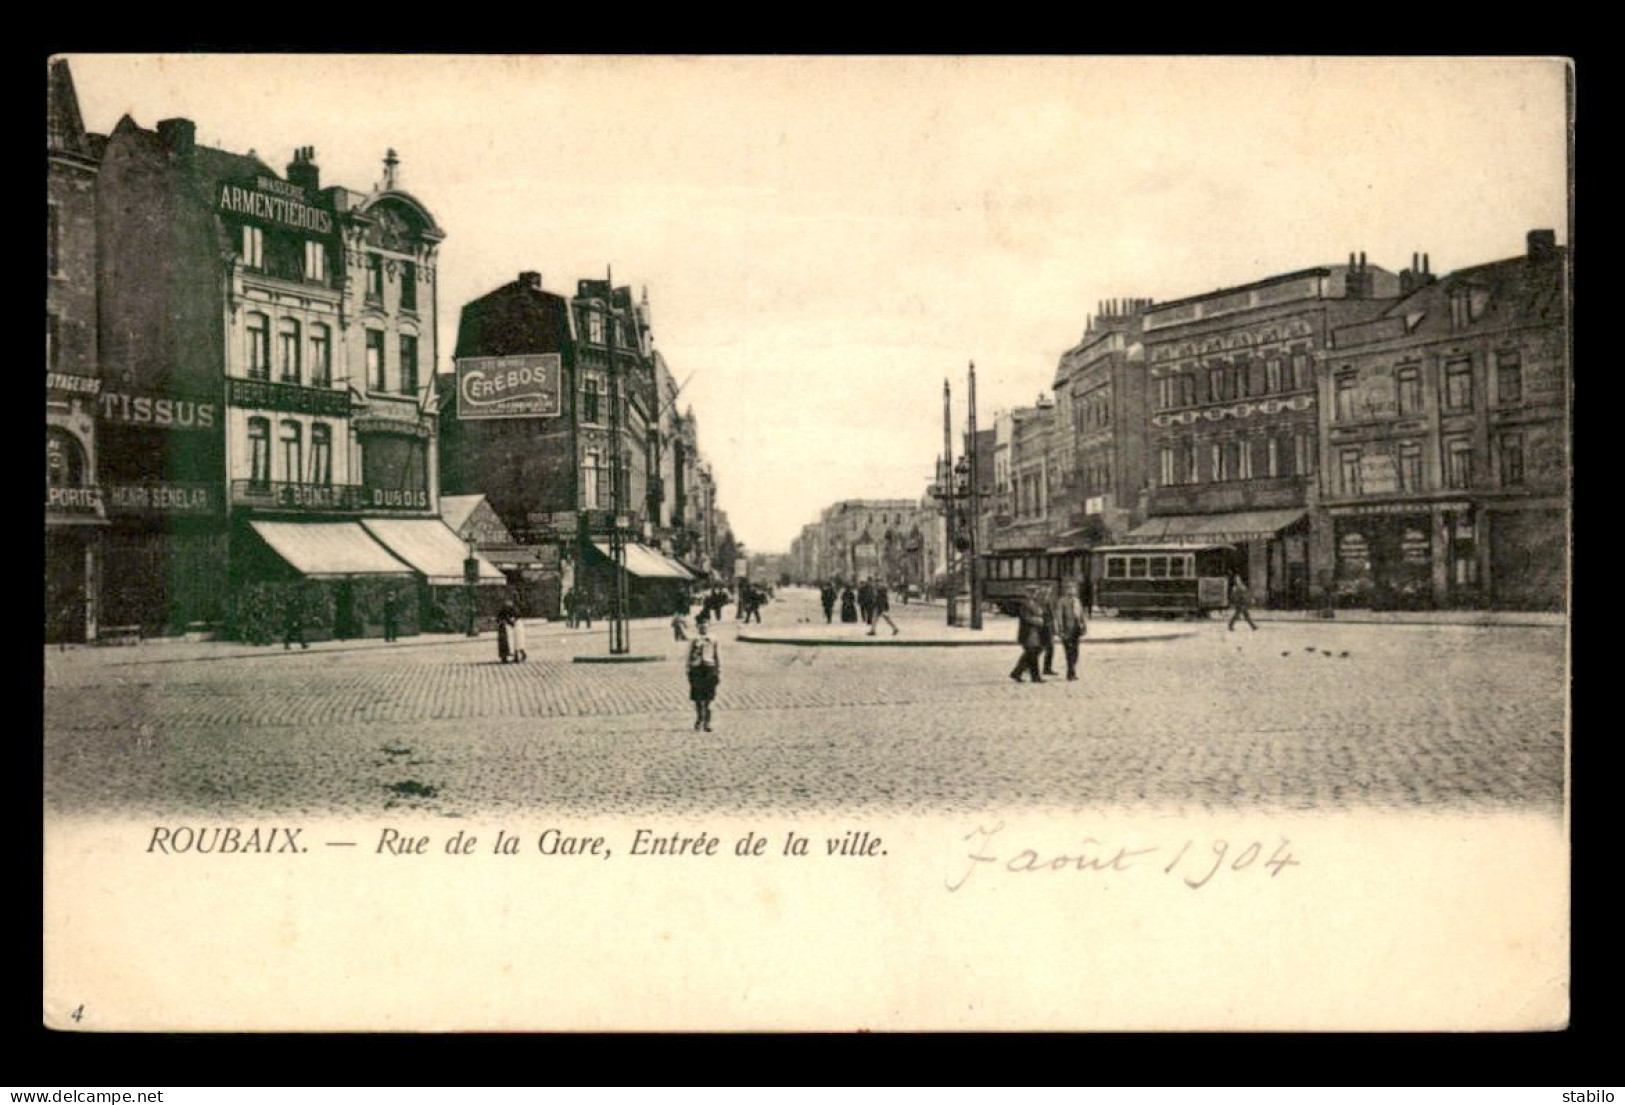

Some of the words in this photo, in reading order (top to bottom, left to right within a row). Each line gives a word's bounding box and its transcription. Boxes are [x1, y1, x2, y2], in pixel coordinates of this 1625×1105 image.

[101, 393, 214, 428] TISSUS
[373, 488, 427, 508] DUBOIS
[147, 827, 309, 854] ROUBAIX.
[376, 827, 430, 856] Rue
[445, 830, 478, 856] de
[494, 830, 521, 856] la
[538, 828, 612, 860] Gare,
[630, 829, 720, 857] Entrée
[735, 831, 768, 857] de
[782, 831, 809, 857] la
[827, 831, 889, 857] ville.
[1164, 839, 1301, 889] 1904
[70, 1003, 85, 1023] 4
